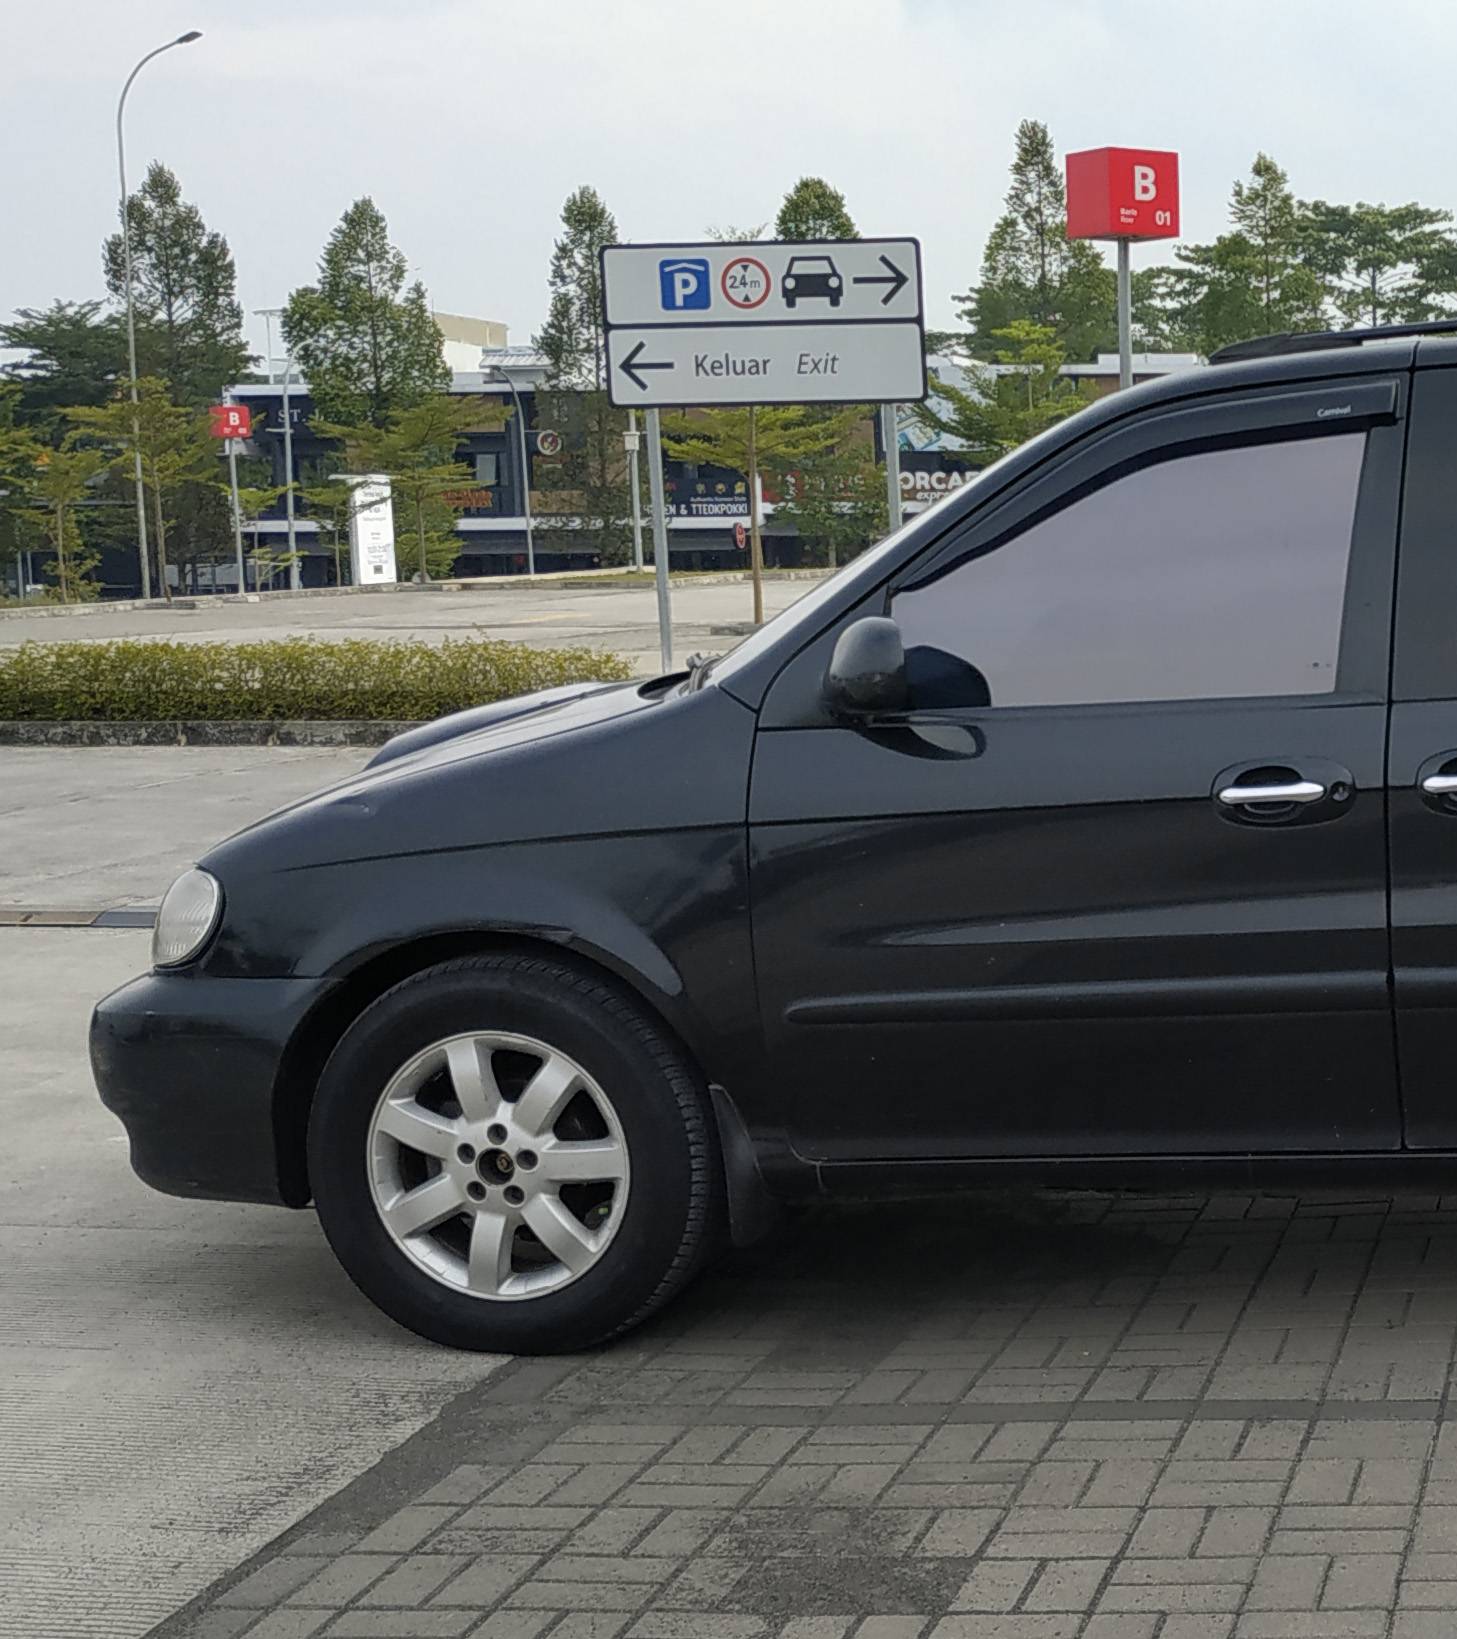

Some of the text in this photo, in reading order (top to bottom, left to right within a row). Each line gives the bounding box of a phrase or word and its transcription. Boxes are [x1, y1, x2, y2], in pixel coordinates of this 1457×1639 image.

[1134, 165, 1156, 201] B
[1155, 210, 1171, 226] 01
[674, 273, 698, 306] P
[694, 352, 839, 376] Keluar Exit
[229, 412, 239, 425] B
[691, 503, 747, 515] TTEOKPOKKI
